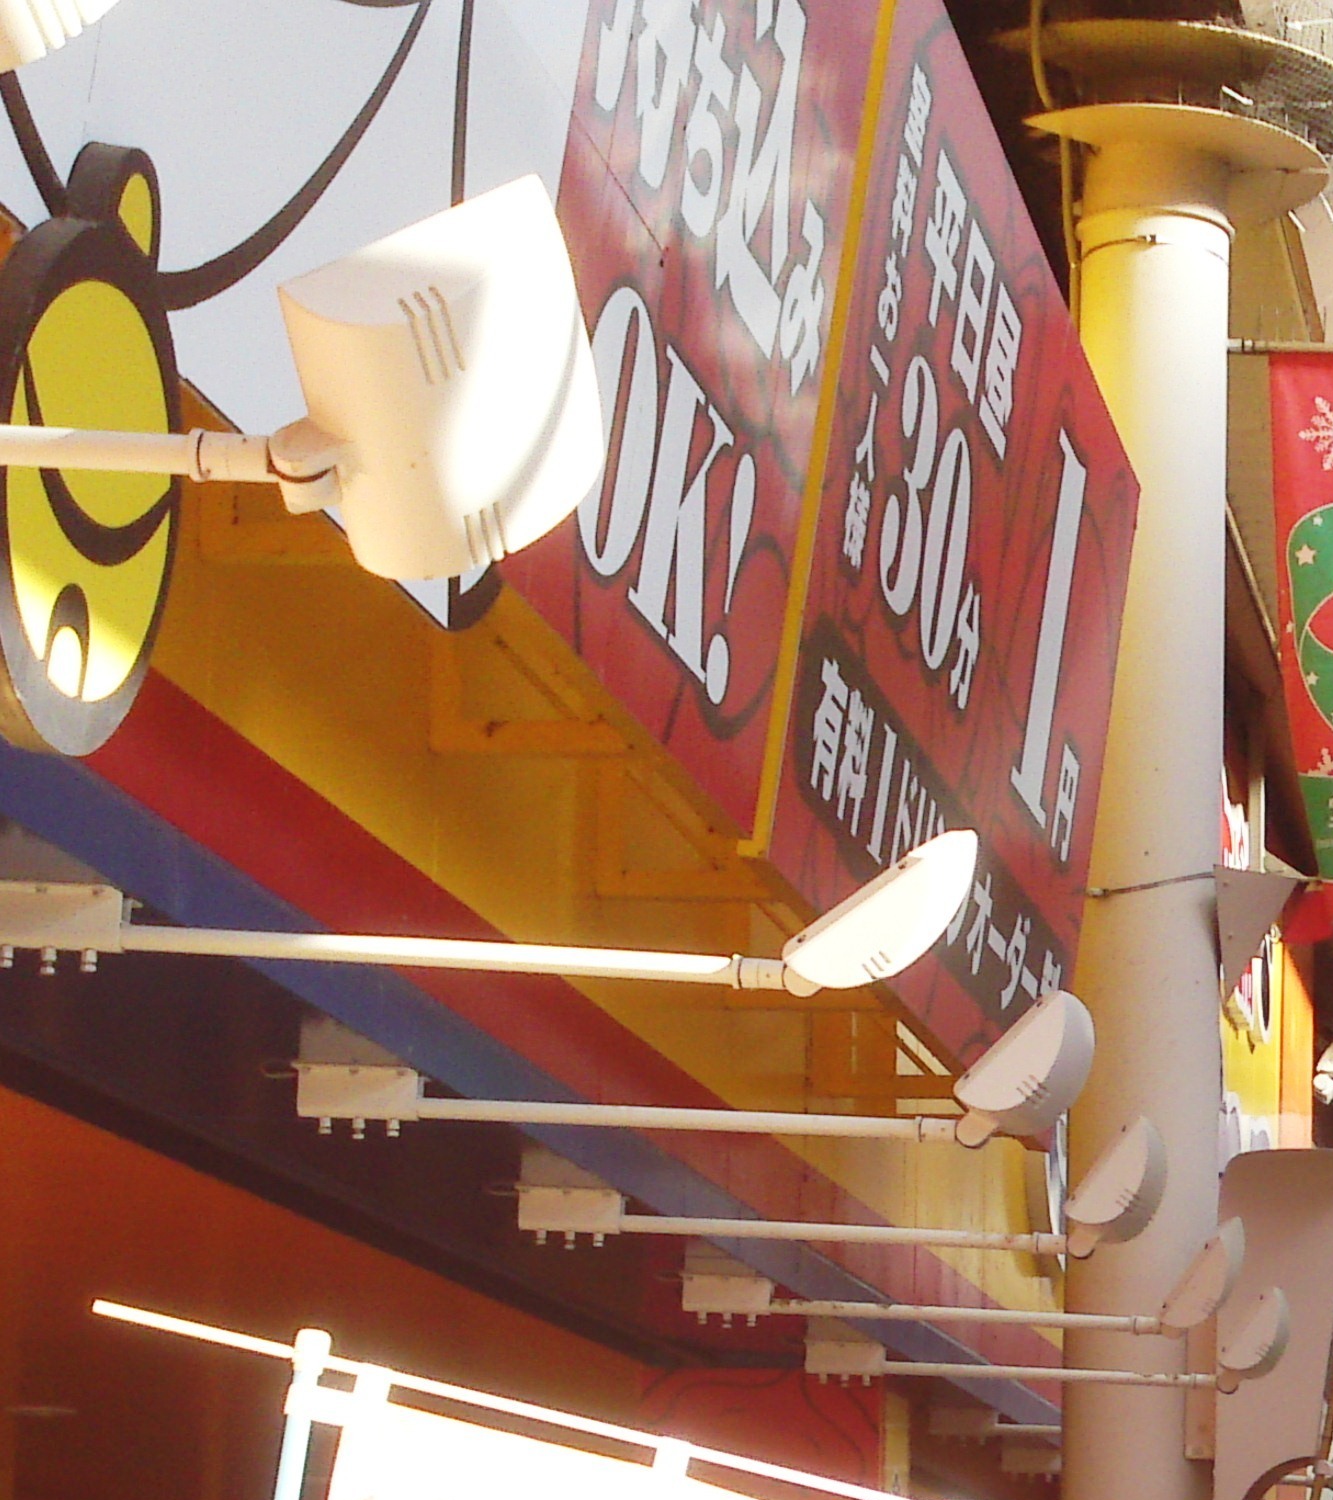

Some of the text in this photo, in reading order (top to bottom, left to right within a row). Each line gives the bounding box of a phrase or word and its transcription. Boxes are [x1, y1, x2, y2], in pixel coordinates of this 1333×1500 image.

[577, 286, 755, 706] OK!
[842, 62, 933, 571] 室料お一人様
[925, 149, 1022, 461] 平日昼
[879, 355, 980, 710] 30分
[1010, 428, 1086, 862] 1円
[810, 657, 1063, 1010] 有料1ドリオーダー
